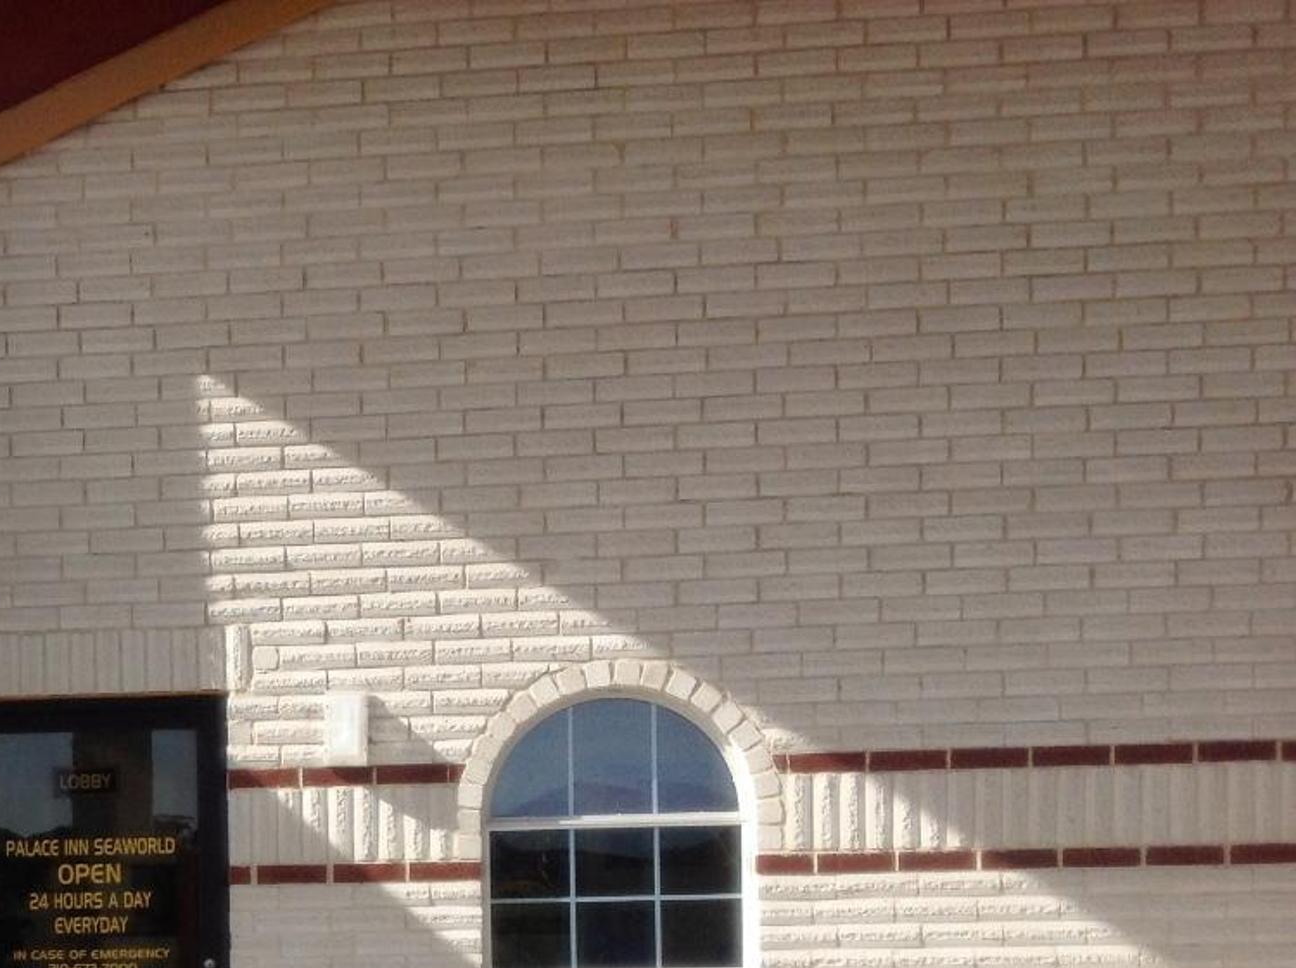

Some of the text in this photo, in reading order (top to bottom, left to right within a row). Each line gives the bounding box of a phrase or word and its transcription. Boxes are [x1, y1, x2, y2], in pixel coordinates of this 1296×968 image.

[60, 773, 112, 790] LOBBY
[6, 836, 176, 857] PALACE INN SEAWORLD
[58, 863, 122, 885] OPEN
[29, 891, 152, 910] 24 HOURS A DAY
[55, 916, 129, 934] EVERYDAY
[14, 948, 170, 960] IN CASE OF EMERGENCY
